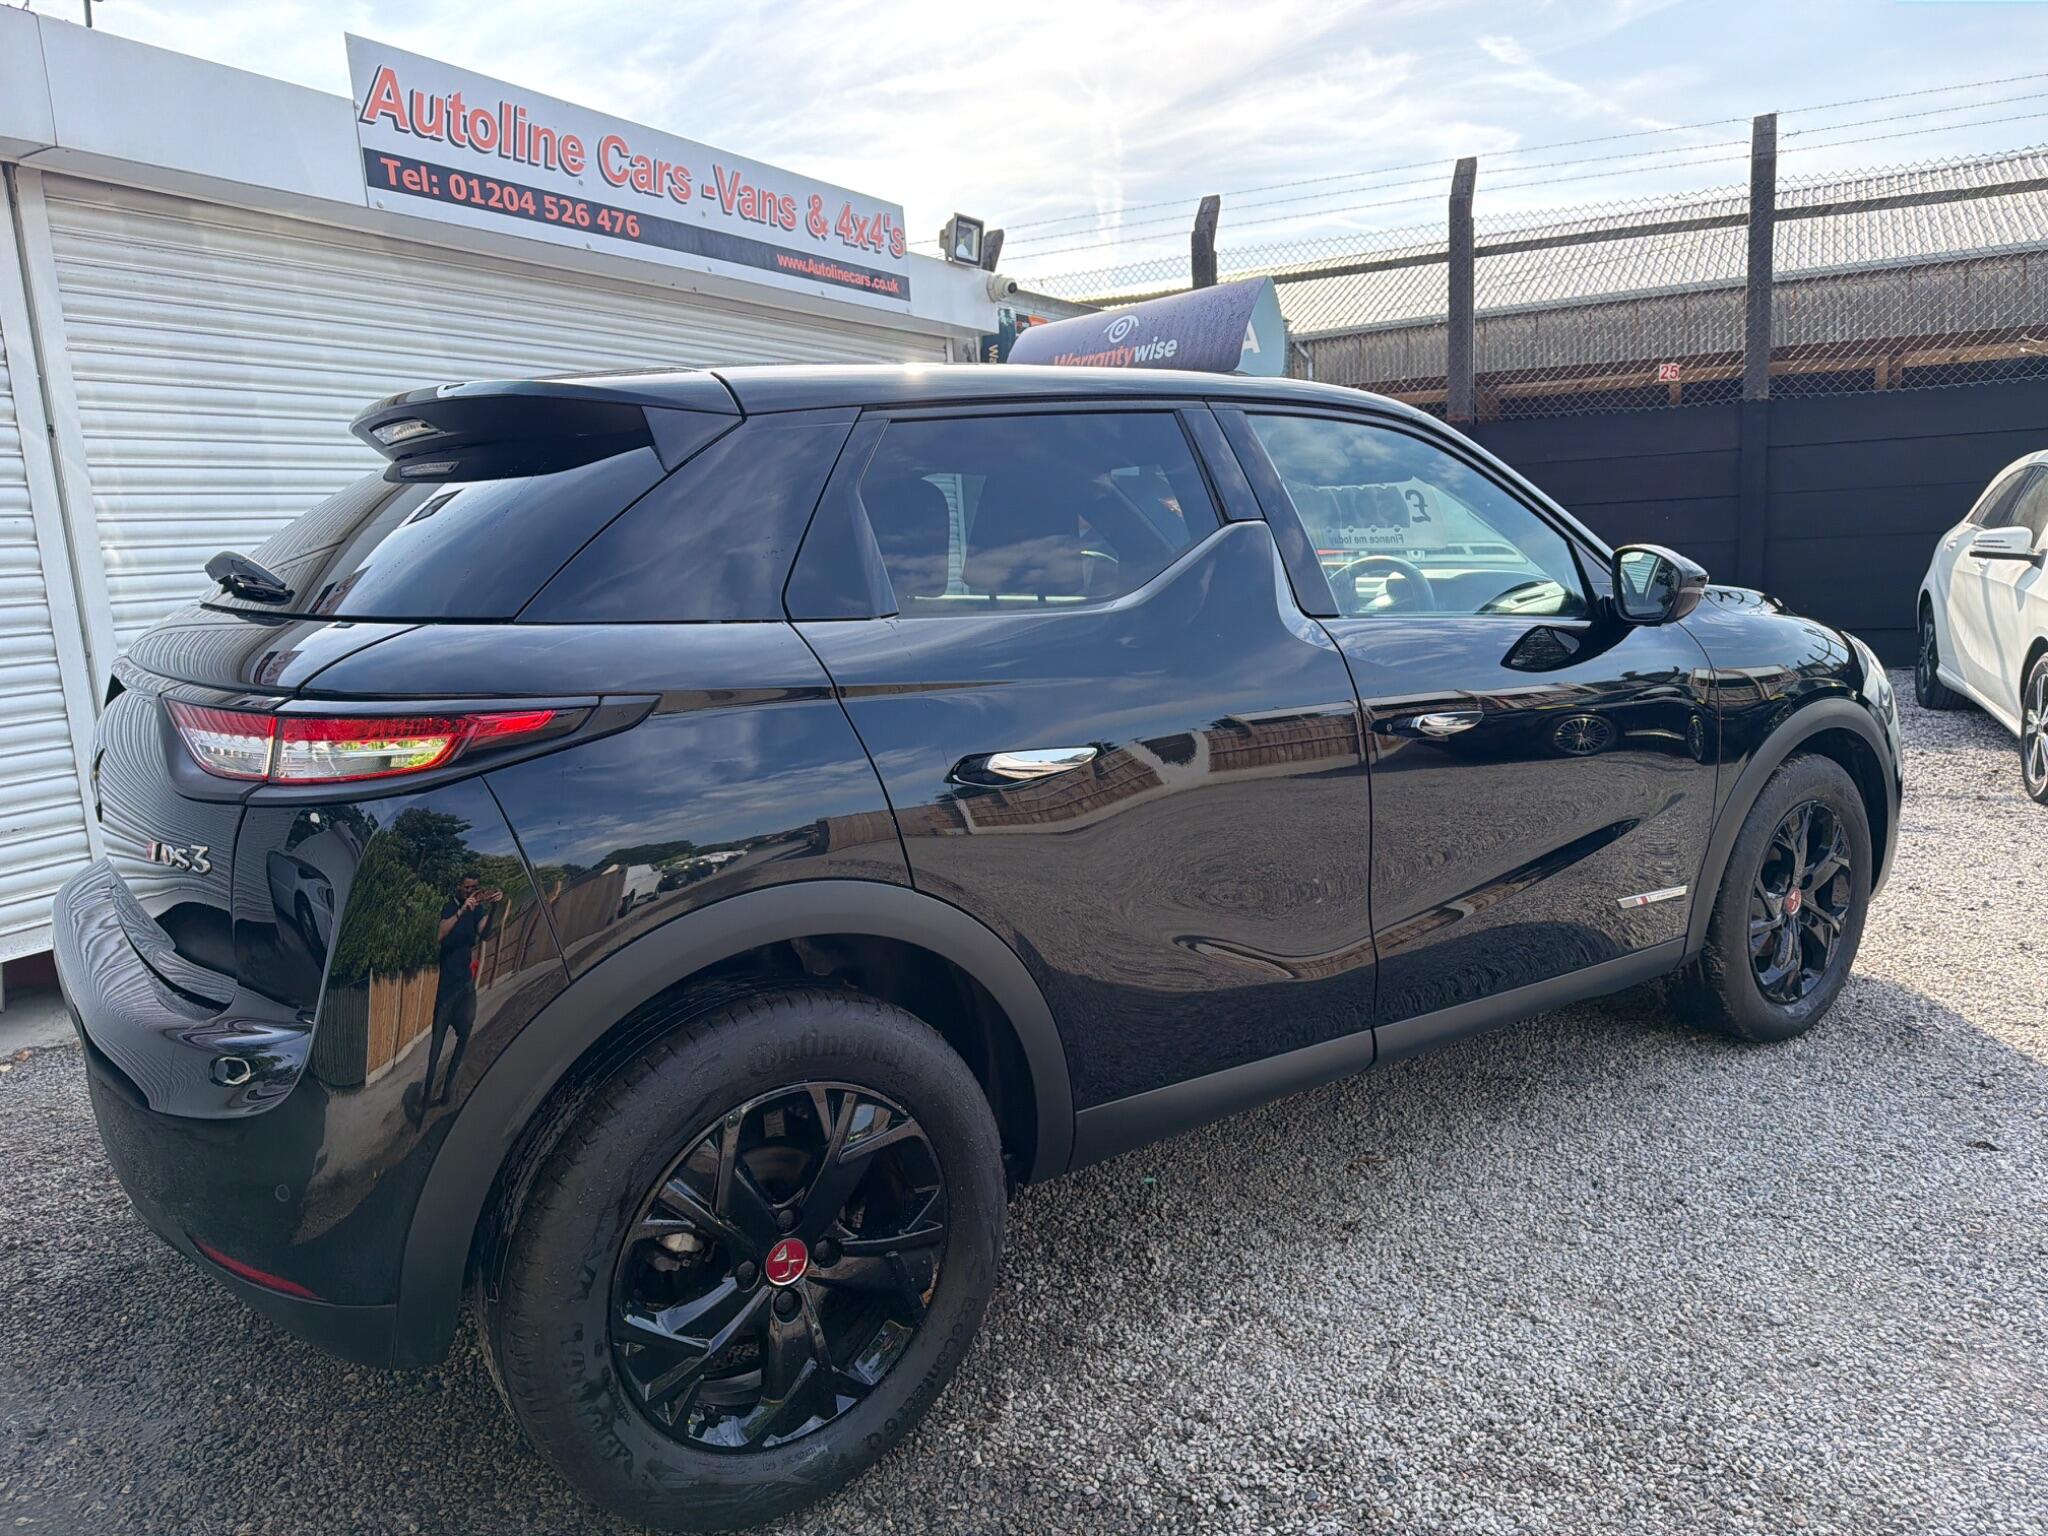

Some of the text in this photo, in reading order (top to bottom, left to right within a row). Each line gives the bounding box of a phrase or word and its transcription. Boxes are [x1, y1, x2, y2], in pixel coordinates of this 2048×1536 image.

[359, 64, 587, 178] Autoline
[597, 134, 693, 205] Cars
[807, 192, 830, 240] &
[835, 201, 907, 259] 4x4's
[380, 156, 641, 238] Tel: 01204 526 476
[776, 253, 899, 293] www.Autolinecars.co.uk
[1660, 365, 1679, 380] 25
